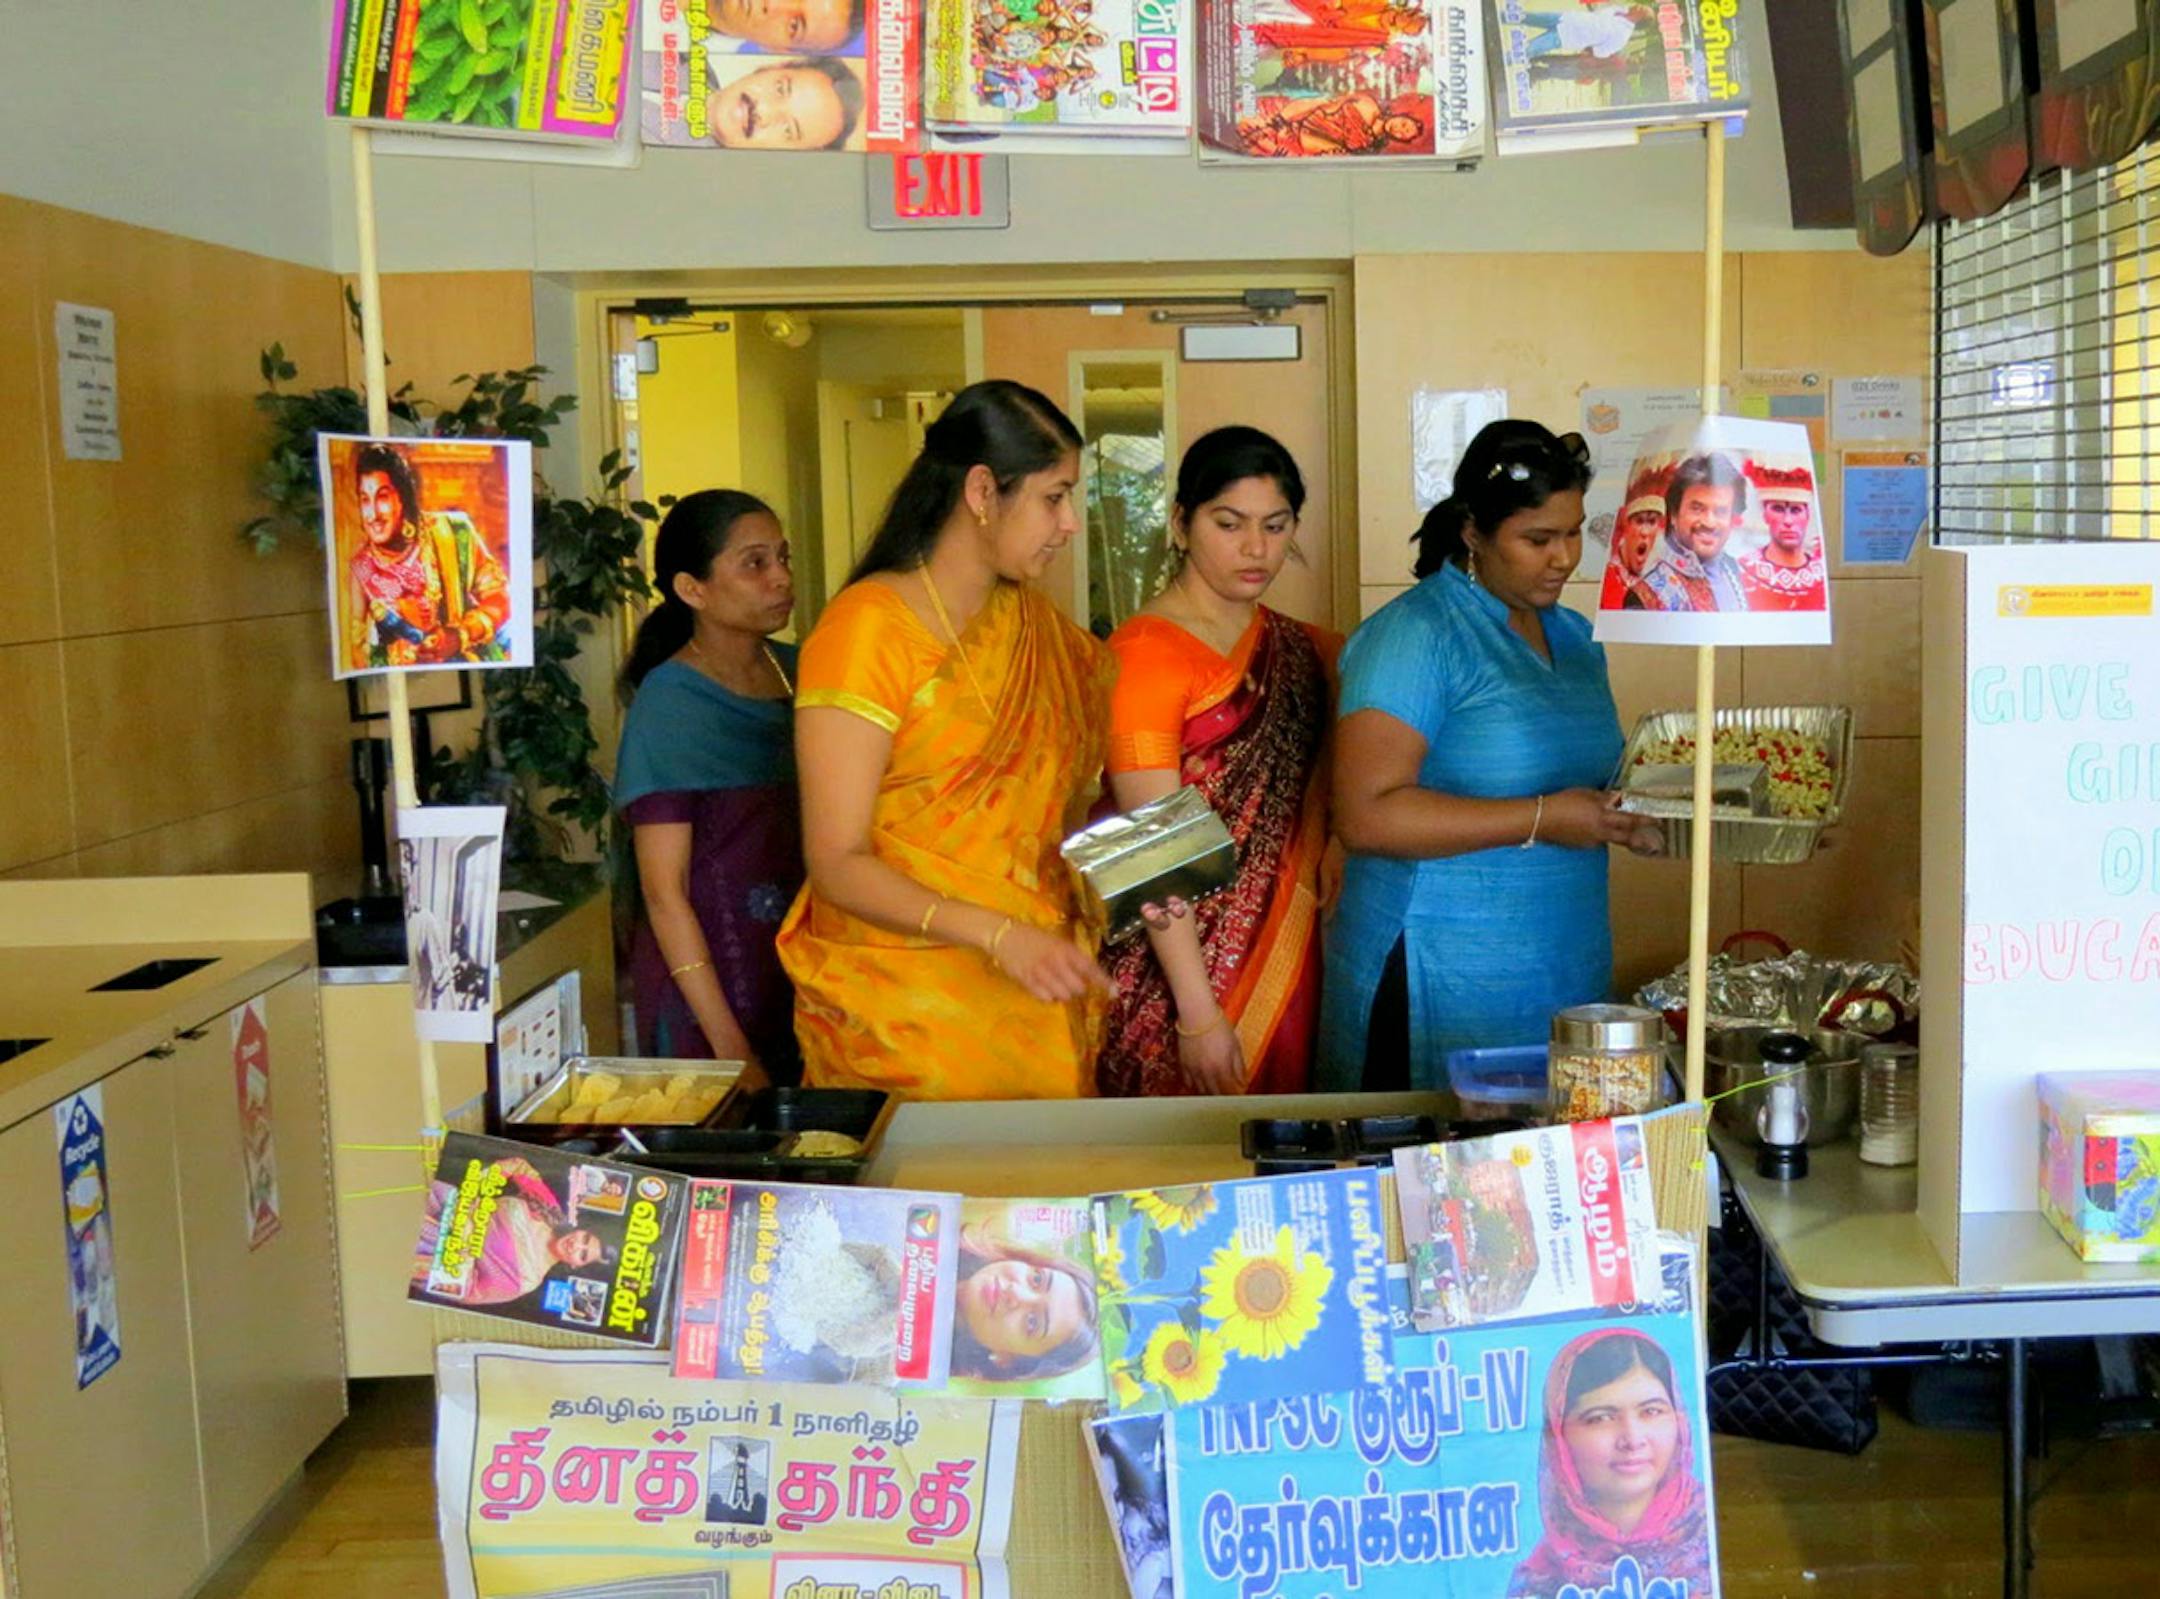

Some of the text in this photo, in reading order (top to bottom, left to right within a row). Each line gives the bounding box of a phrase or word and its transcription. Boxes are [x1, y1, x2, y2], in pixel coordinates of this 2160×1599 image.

[685, 47, 713, 138] கொள்ளும்
[1448, 5, 1478, 135] காக்கைச்
[897, 153, 984, 218] EXIT
[1971, 662, 2134, 725] GIVE
[2067, 741, 2160, 805] GI
[2101, 826, 2160, 897] O
[443, 1158, 483, 1277] விஜயகாந்த்?
[469, 1163, 507, 1259] வீழ்கிறாரா
[1538, 1132, 1572, 1231] குஜராத்
[1580, 1147, 1628, 1278] ஆழம்
[608, 1200, 661, 1333] விகடன்
[739, 1190, 780, 1376] அரிசிக்கு ஆபத்து!
[898, 1243, 920, 1362] தலைமுறை
[918, 1246, 938, 1293] புதிய
[1345, 1181, 1396, 1386] பனிப்பூக்கள்
[549, 1395, 920, 1447] தமிழில் நம்பர் 1 நாளிதழ்
[479, 1427, 978, 1546] தினத் தந்தி
[1202, 1469, 1520, 1599] தேர்வுக்கான
[694, 1528, 774, 1548] வழங்கும்
